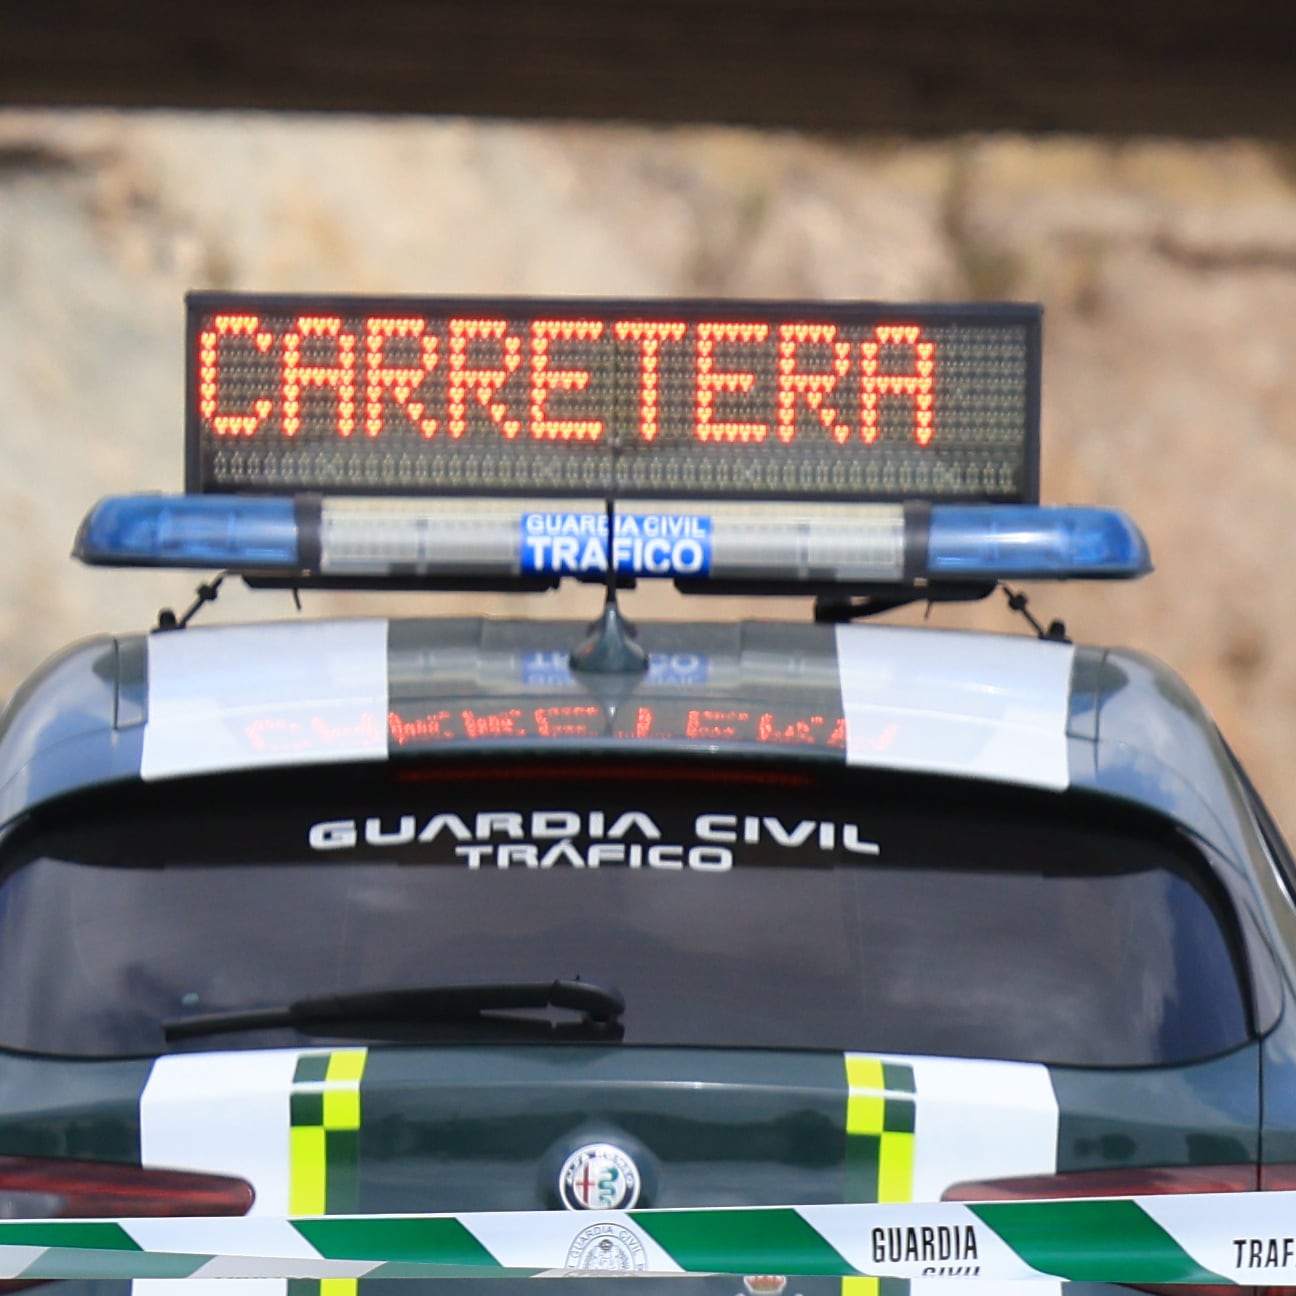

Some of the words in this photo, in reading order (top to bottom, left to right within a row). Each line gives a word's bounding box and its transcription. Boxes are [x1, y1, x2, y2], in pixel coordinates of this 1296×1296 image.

[200, 316, 936, 444] CARRETERA
[526, 514, 639, 536] GUARDIA
[643, 515, 706, 538] CIVIL
[526, 535, 704, 574] TRAFICO
[309, 811, 661, 850] GUARDIA
[695, 814, 881, 855] CIVIL
[455, 839, 734, 871] TRÁFICO
[872, 1225, 978, 1263] GUARDIA
